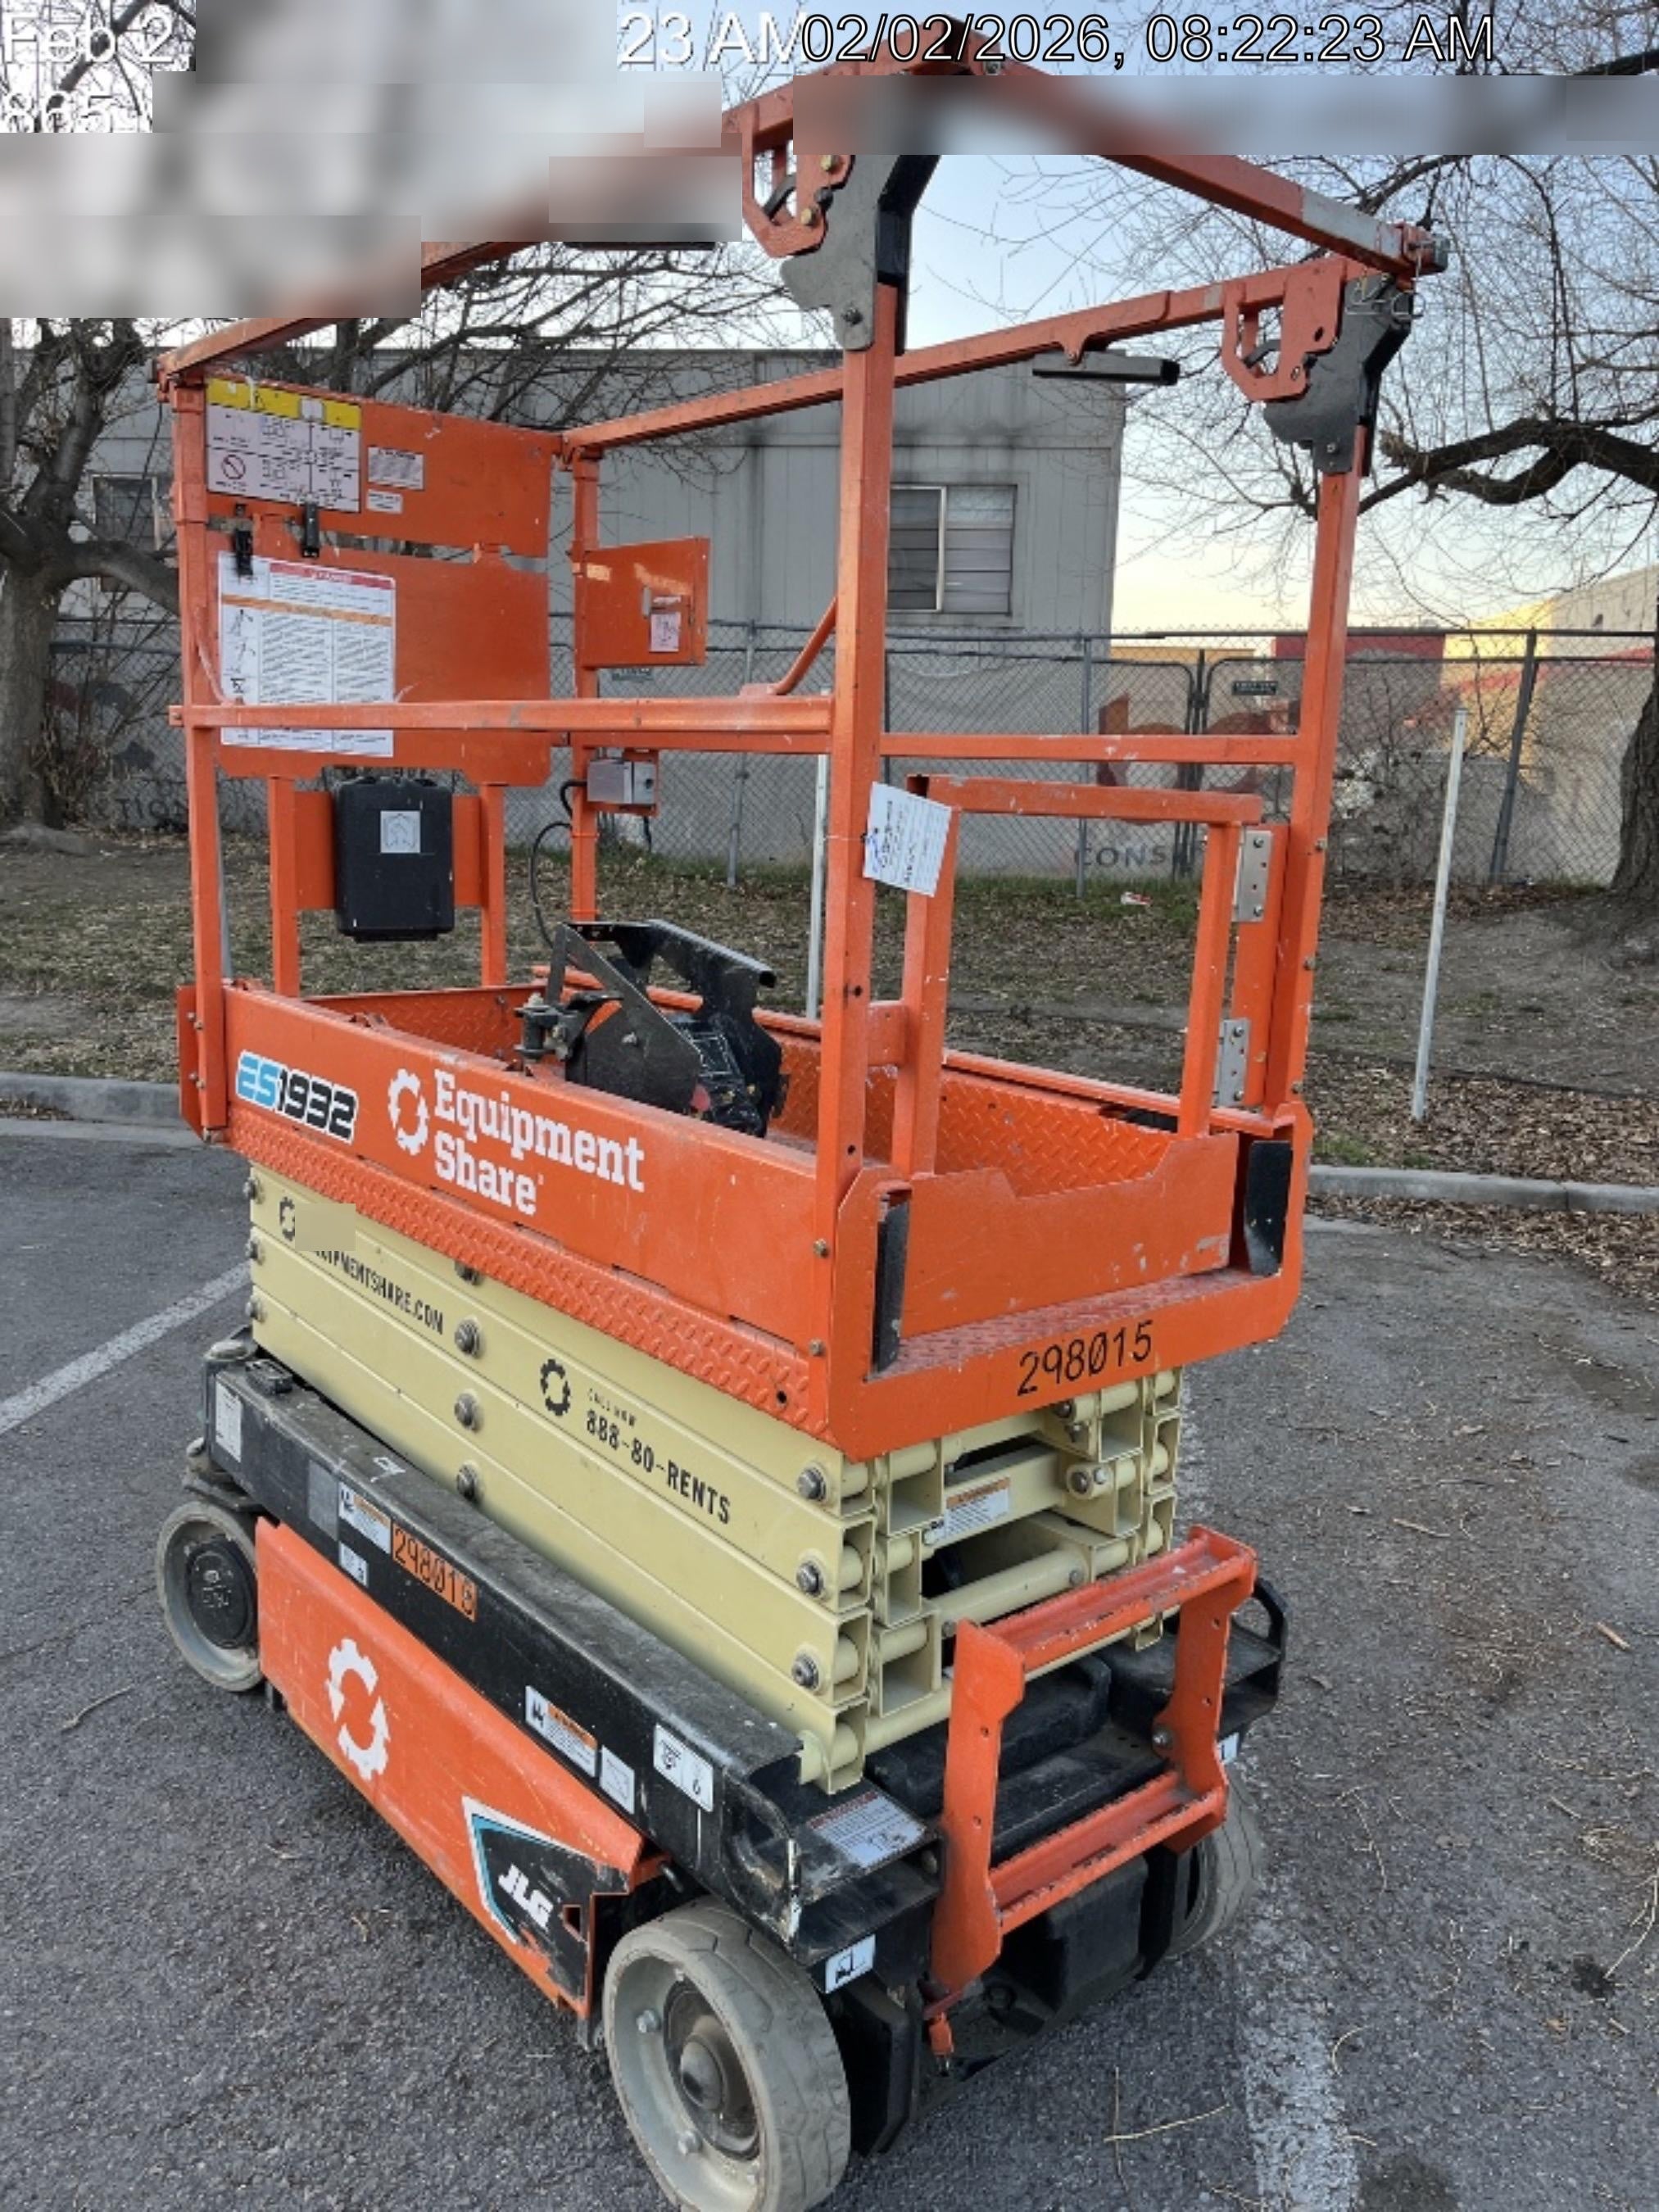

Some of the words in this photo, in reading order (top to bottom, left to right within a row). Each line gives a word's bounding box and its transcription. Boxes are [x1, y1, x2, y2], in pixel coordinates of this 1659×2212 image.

[236, 1049, 359, 1145] ES1932
[434, 1068, 645, 1193] Equipment
[434, 1131, 537, 1216] Share
[1018, 1319, 1154, 1397] 298015
[586, 1408, 731, 1525] 888-80-RENTS
[497, 1863, 555, 1932] JLG
